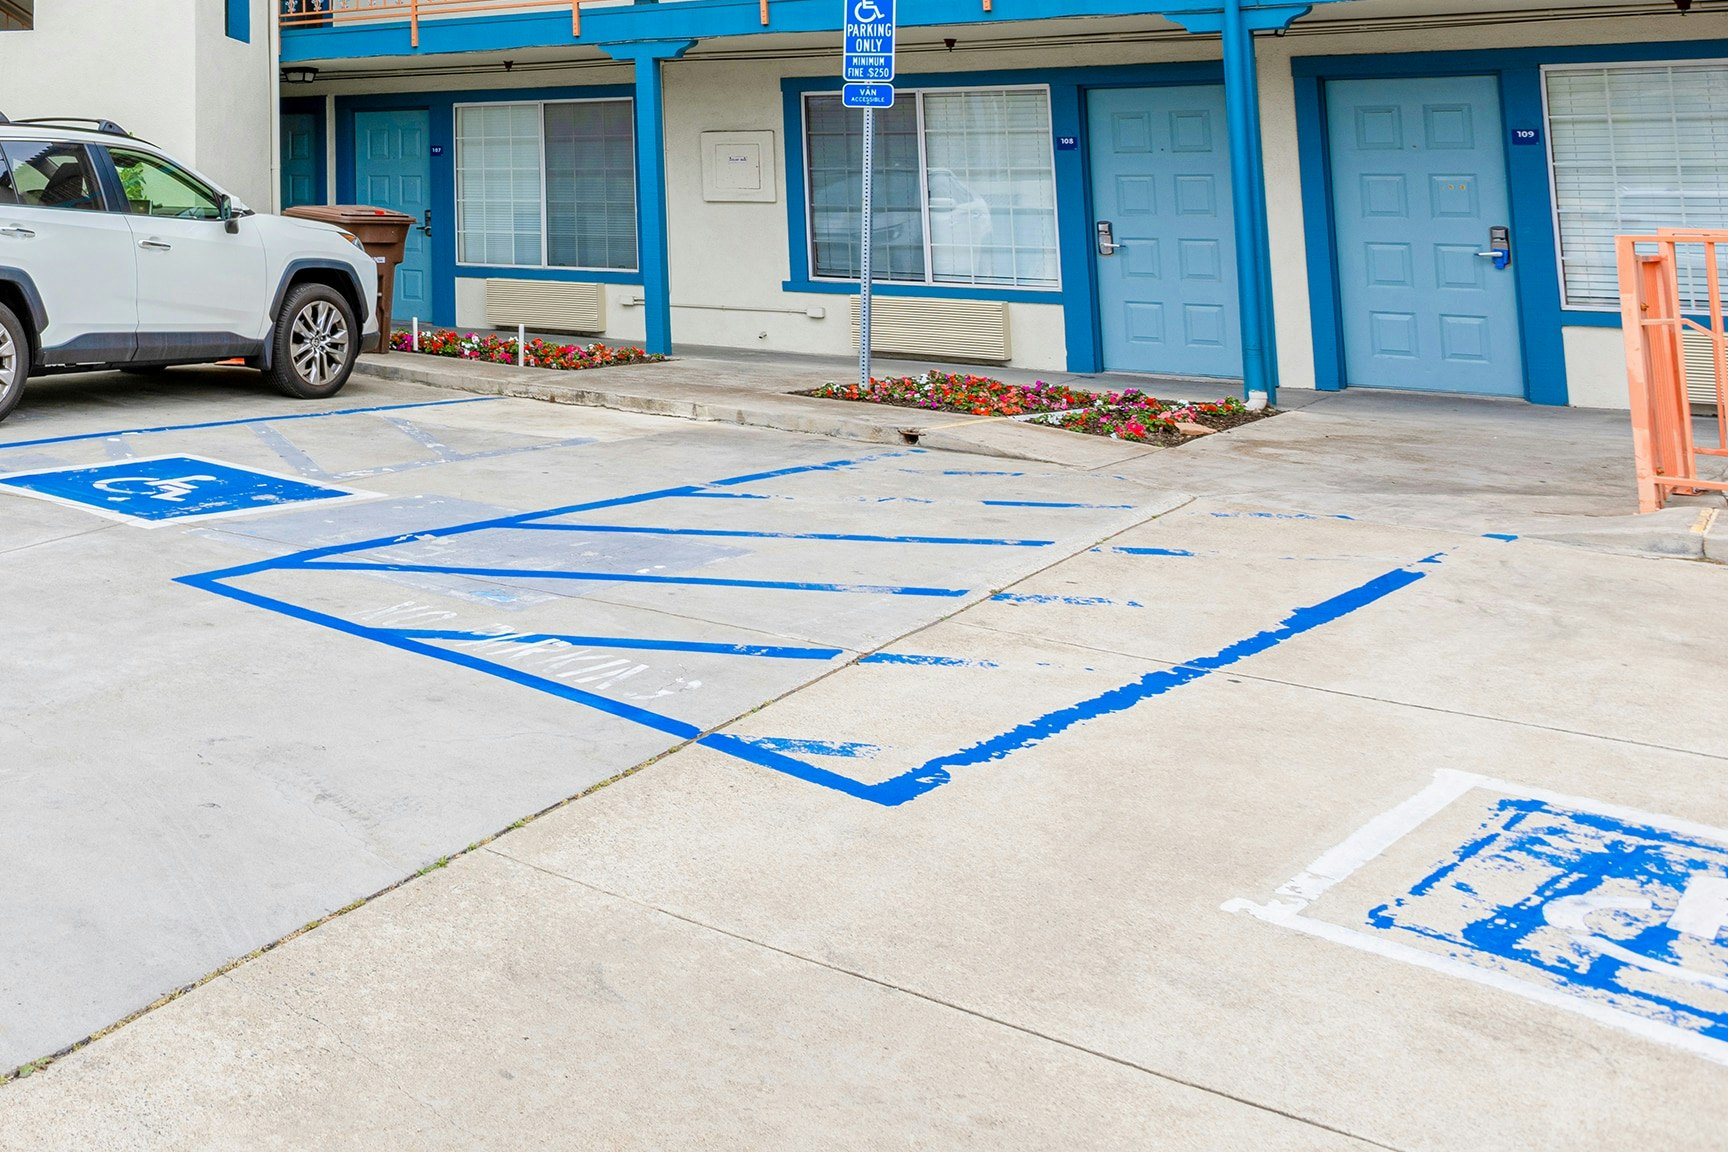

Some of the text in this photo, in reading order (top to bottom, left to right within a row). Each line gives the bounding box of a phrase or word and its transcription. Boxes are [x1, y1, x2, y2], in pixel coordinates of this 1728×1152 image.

[847, 23, 892, 37] PARKING
[855, 38, 883, 52] ONLY
[852, 56, 885, 66] MINIMUM
[847, 67, 890, 78] FINE $250
[859, 88, 877, 96] VAN
[1516, 130, 1535, 138] 109
